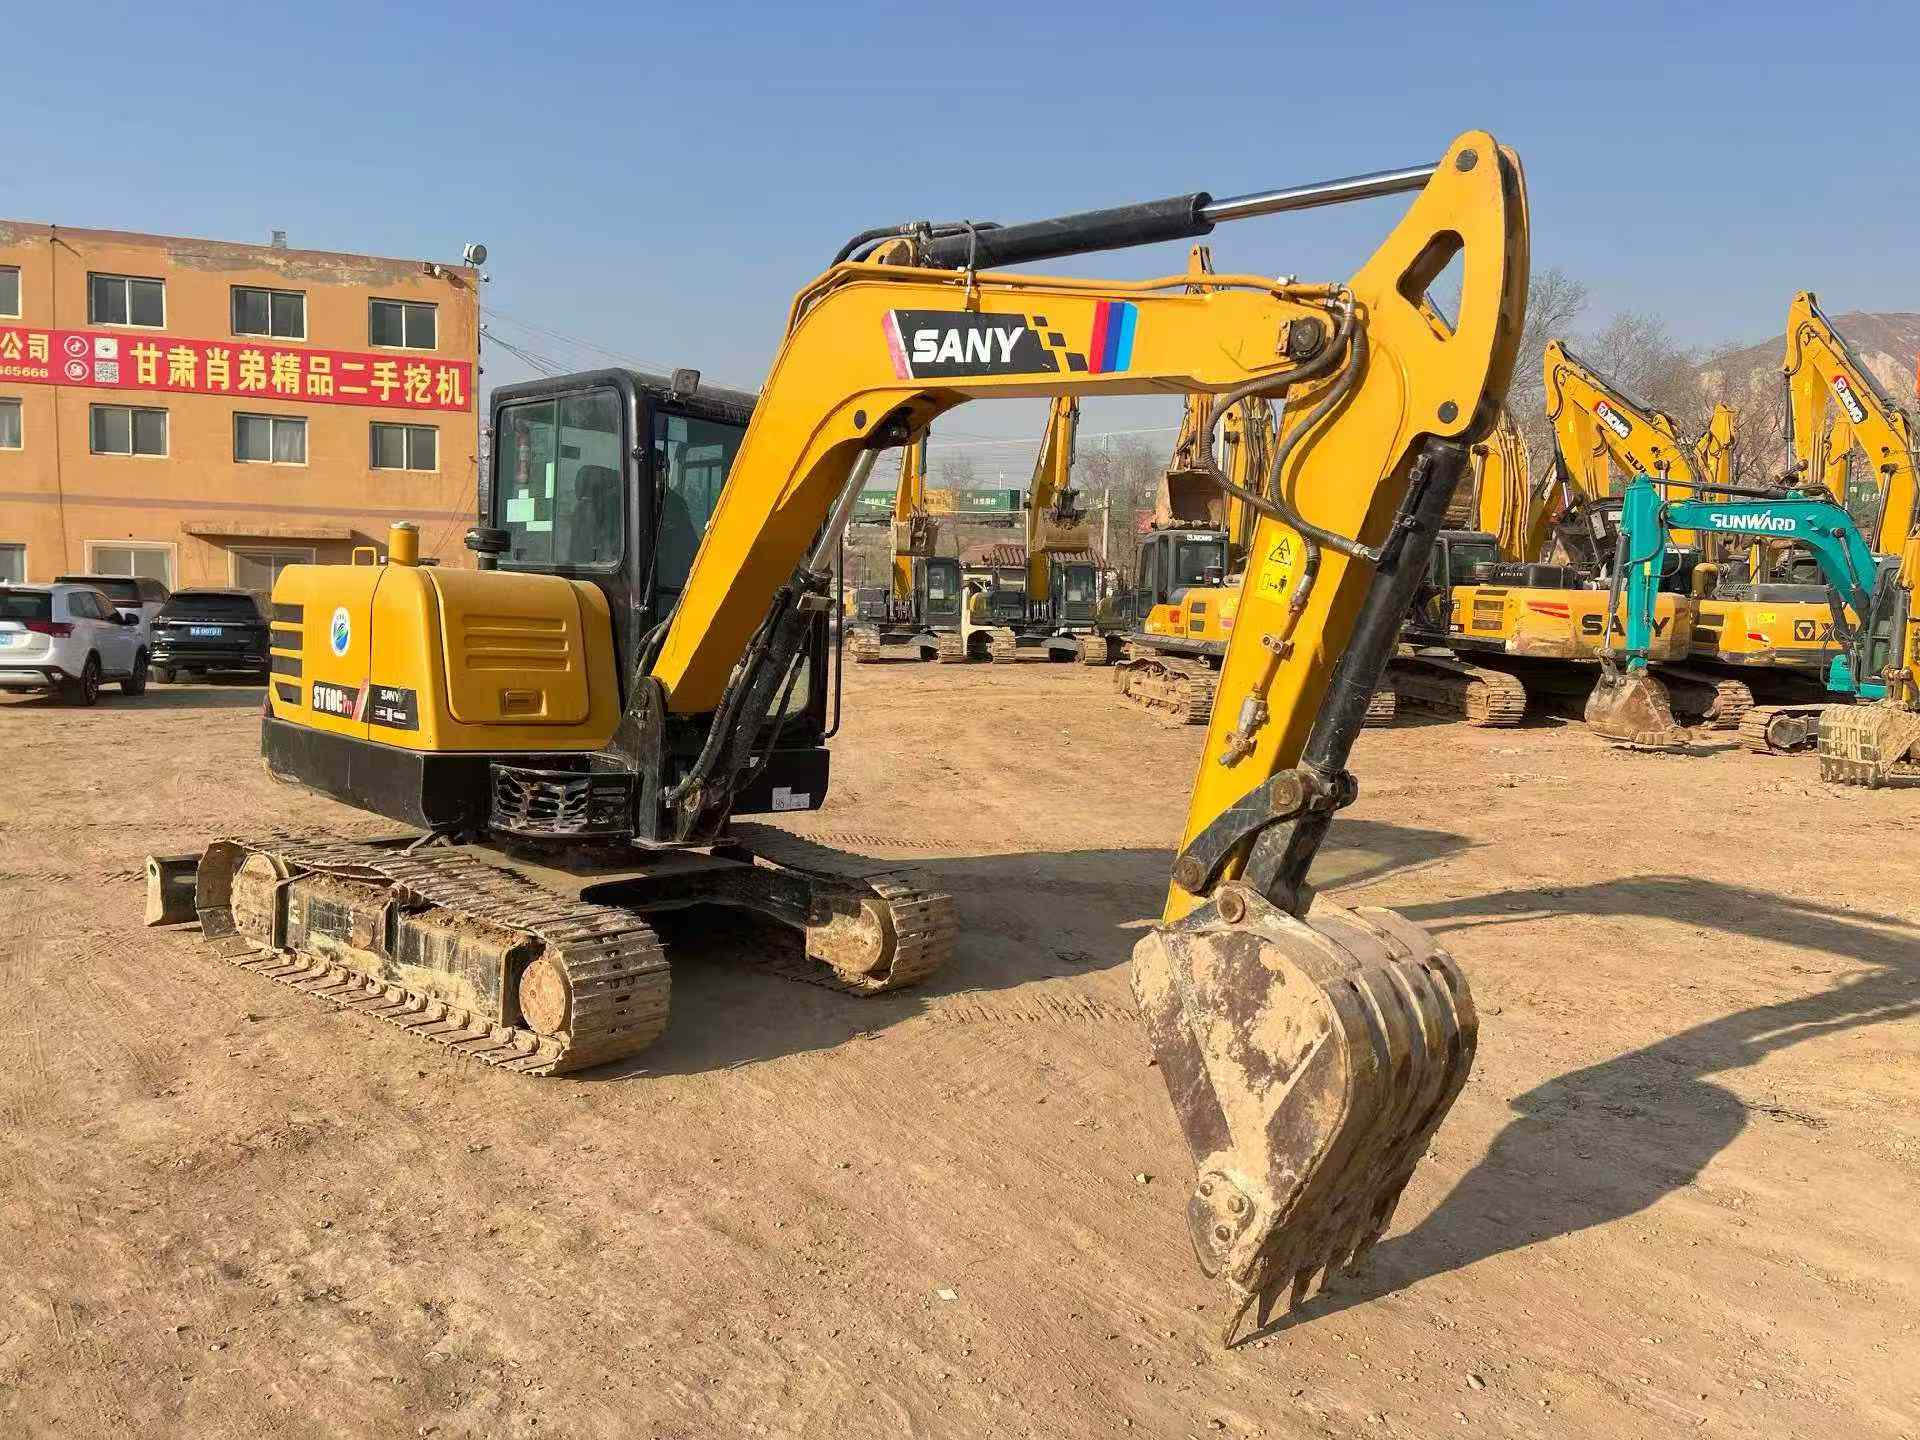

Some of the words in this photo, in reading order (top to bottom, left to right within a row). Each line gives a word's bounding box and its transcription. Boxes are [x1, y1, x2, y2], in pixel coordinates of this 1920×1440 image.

[1, 332, 48, 363] 公司
[911, 327, 1024, 363] SANY
[130, 342, 465, 406] 甘肃肖弟精品二手挖机
[1711, 510, 1796, 531] SUNWARD
[1581, 614, 1670, 637] SAY
